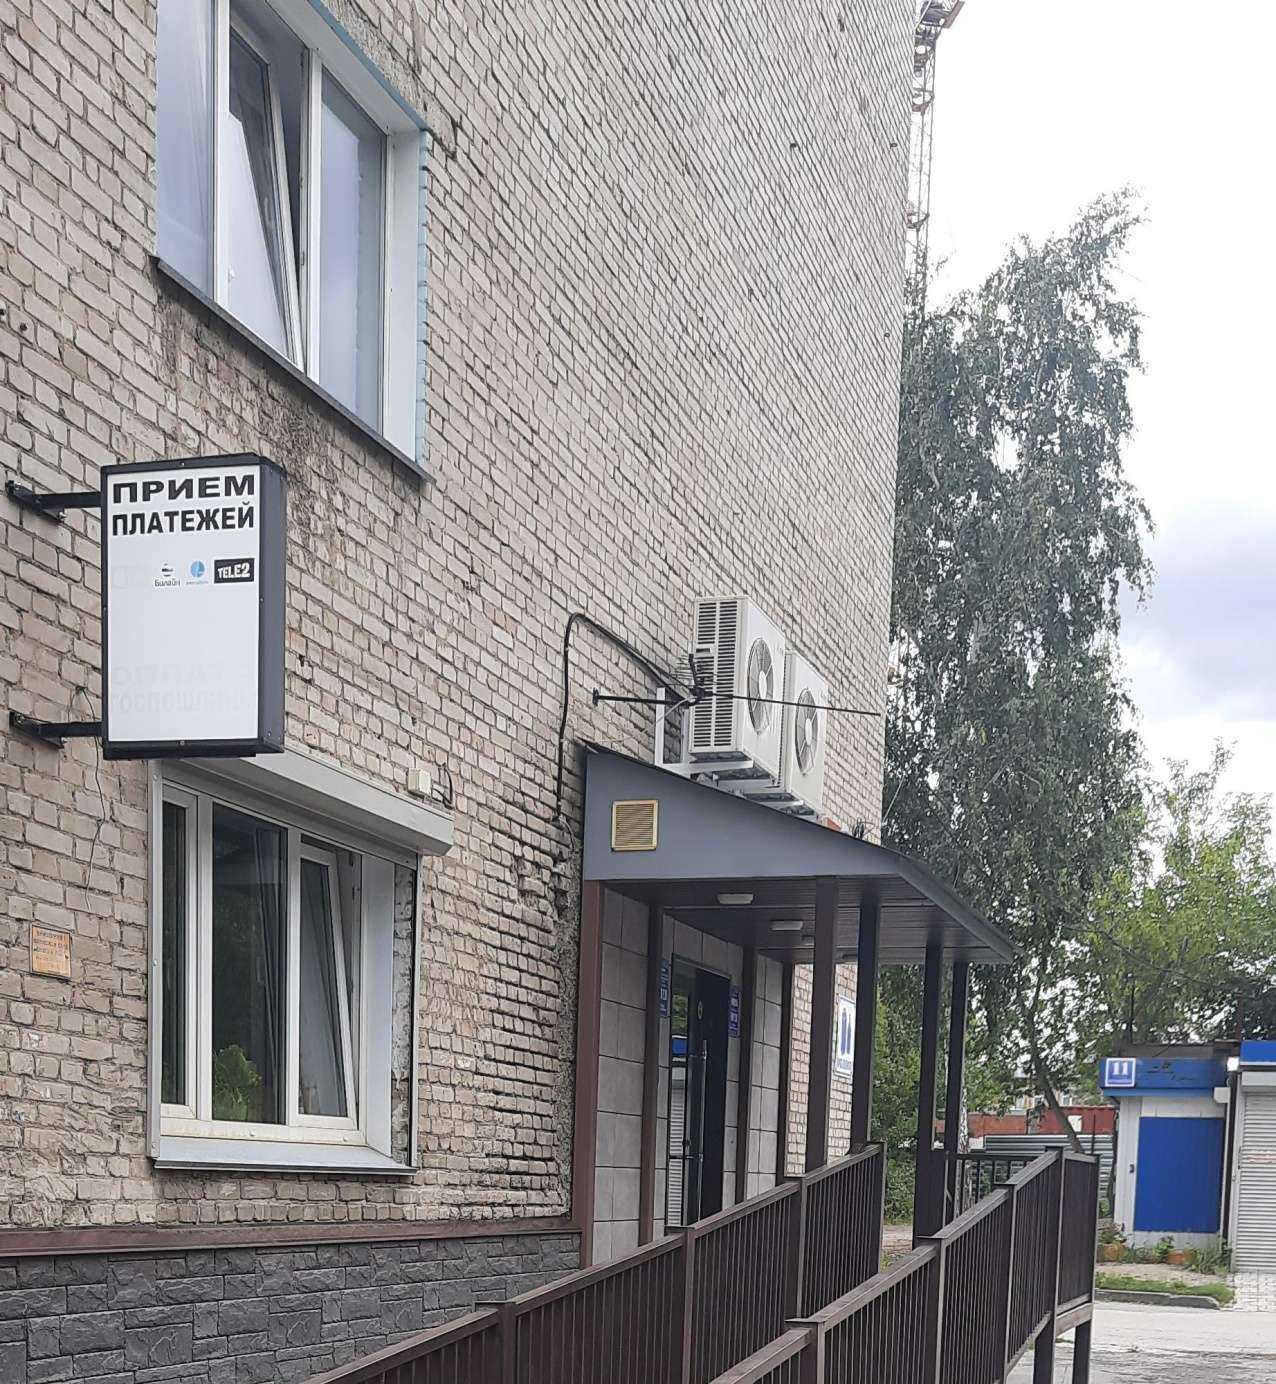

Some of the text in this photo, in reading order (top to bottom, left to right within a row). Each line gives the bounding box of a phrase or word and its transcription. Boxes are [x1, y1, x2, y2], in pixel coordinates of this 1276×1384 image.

[112, 474, 255, 504] ПРИЕМ
[112, 502, 254, 536] ПЛАТЕЖЕЙ
[217, 562, 250, 579] TELE2
[1111, 1061, 1129, 1075] 11
